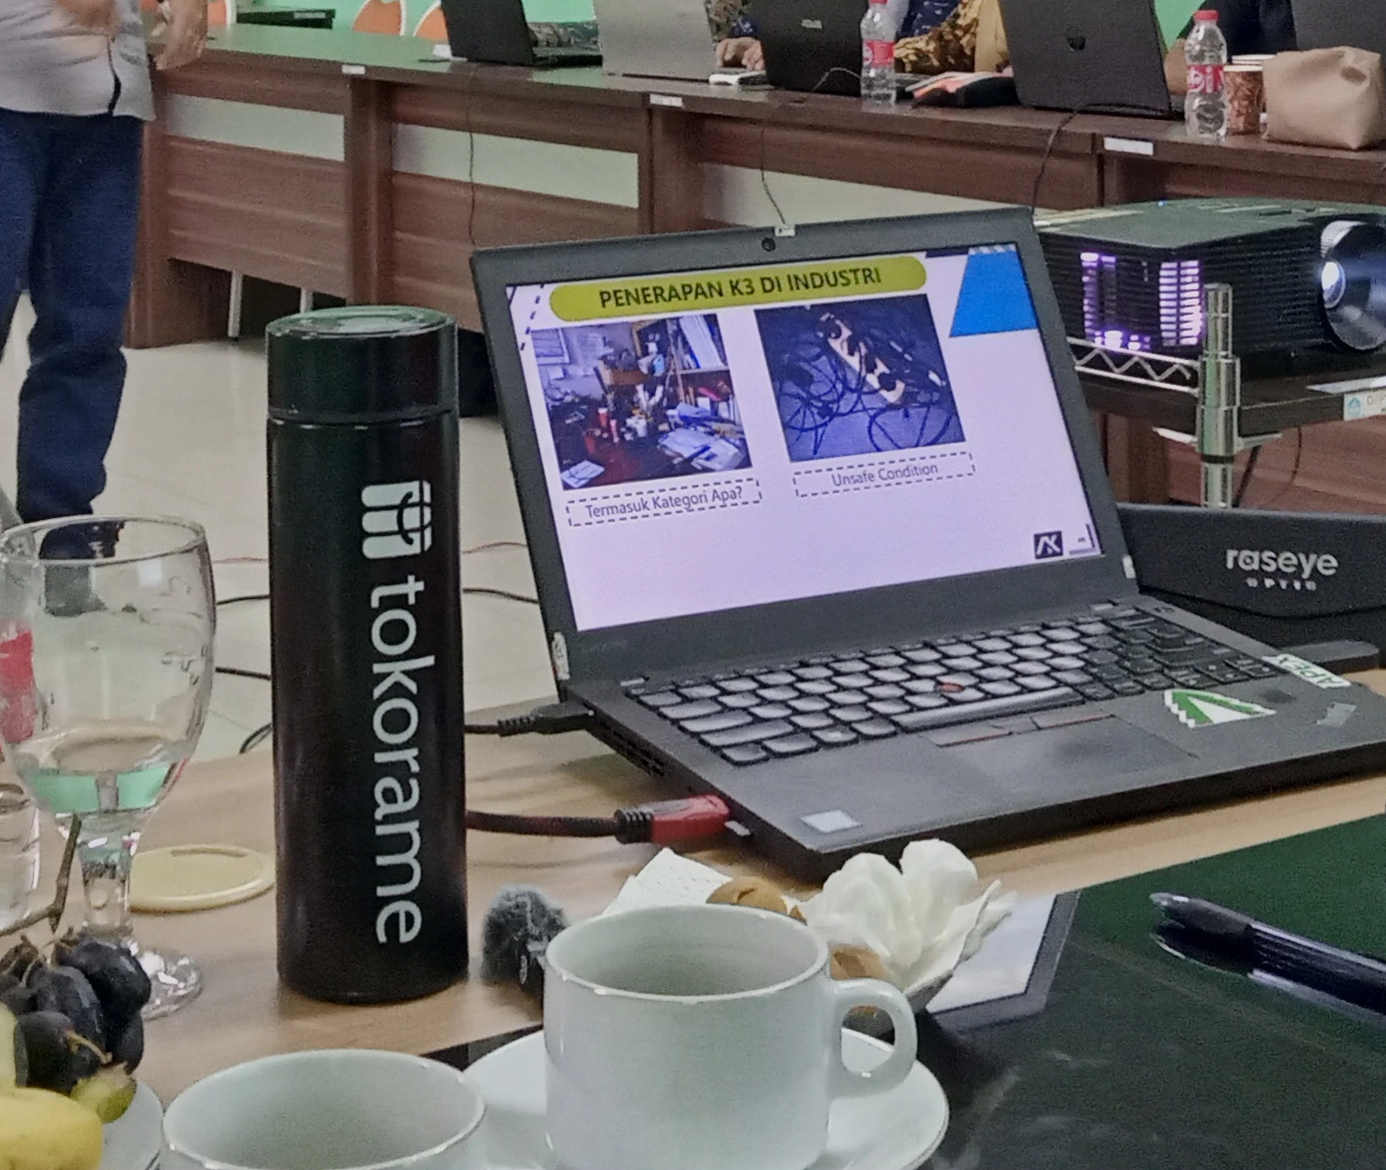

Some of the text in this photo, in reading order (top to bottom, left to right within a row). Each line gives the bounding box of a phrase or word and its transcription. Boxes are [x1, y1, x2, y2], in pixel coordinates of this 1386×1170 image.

[598, 266, 882, 308] PENERAPAN K3 DI INDUSTRI
[831, 464, 939, 487] Unsafe Condition
[585, 485, 743, 519] Termasuk Kategori Apa?
[1226, 549, 1339, 580] raseye
[369, 574, 435, 944] tokorame
